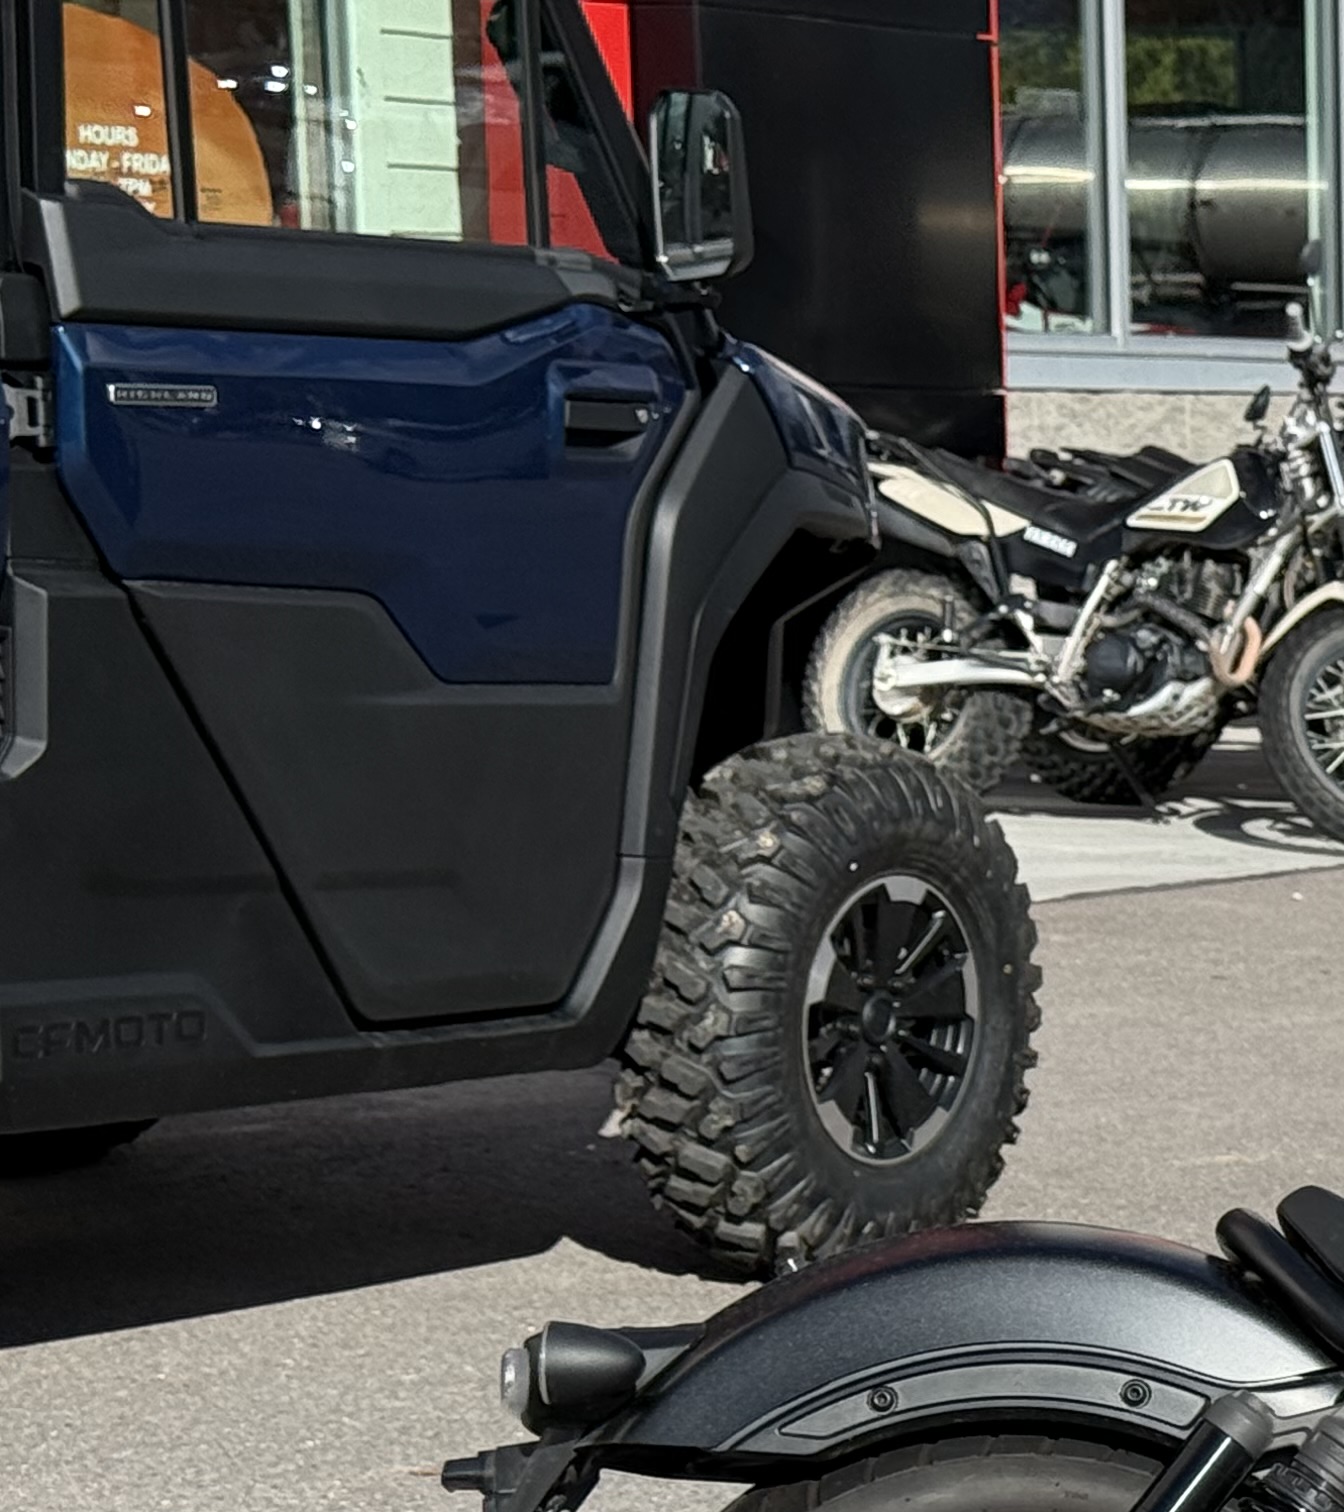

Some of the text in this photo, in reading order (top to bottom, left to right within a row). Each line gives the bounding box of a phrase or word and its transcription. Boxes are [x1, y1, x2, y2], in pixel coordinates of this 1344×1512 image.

[78, 124, 139, 147] HOURS
[66, 149, 110, 172] NDAY
[121, 150, 171, 175] FRIDA
[14, 1010, 209, 1059] CFMOTO
